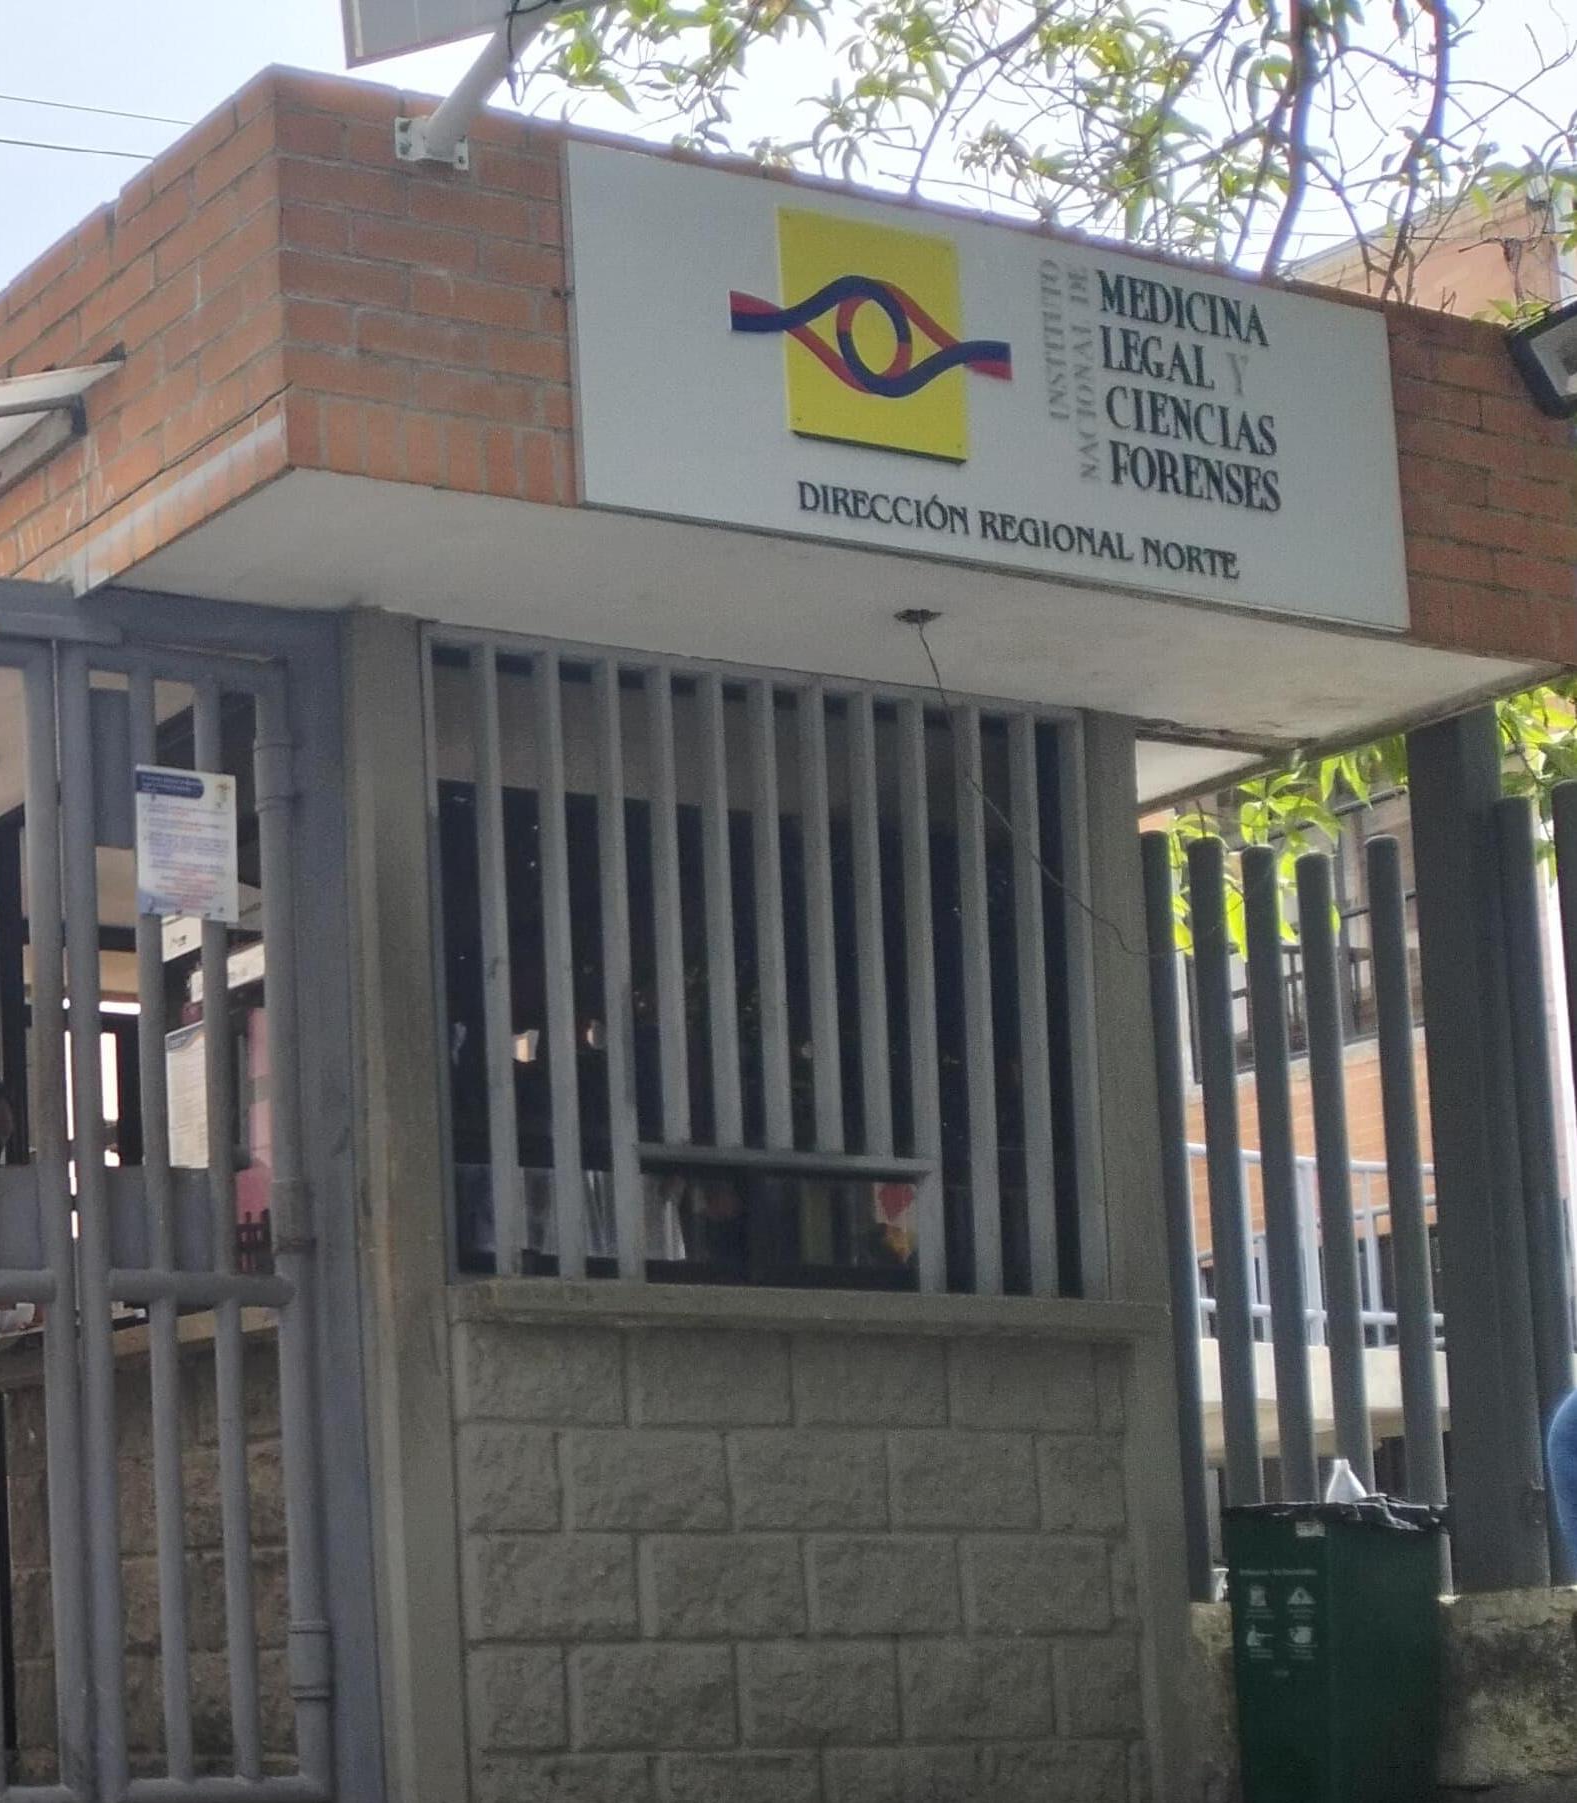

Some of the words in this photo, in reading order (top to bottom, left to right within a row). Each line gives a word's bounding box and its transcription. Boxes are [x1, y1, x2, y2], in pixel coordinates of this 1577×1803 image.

[1068, 267, 1089, 304] DE
[1097, 269, 1269, 347] MEDICINA
[1039, 259, 1070, 420] INSTITUTO
[1099, 325, 1215, 391] LEGAL
[1226, 352, 1249, 396] Y
[1072, 322, 1101, 482] NACIONAL
[1106, 386, 1278, 456] CIENCIAS
[1109, 440, 1282, 512] FORENSES
[797, 480, 970, 534] DIRECCIÓN
[979, 510, 1134, 561] REGIONAL
[1141, 536, 1240, 580] NORTE
